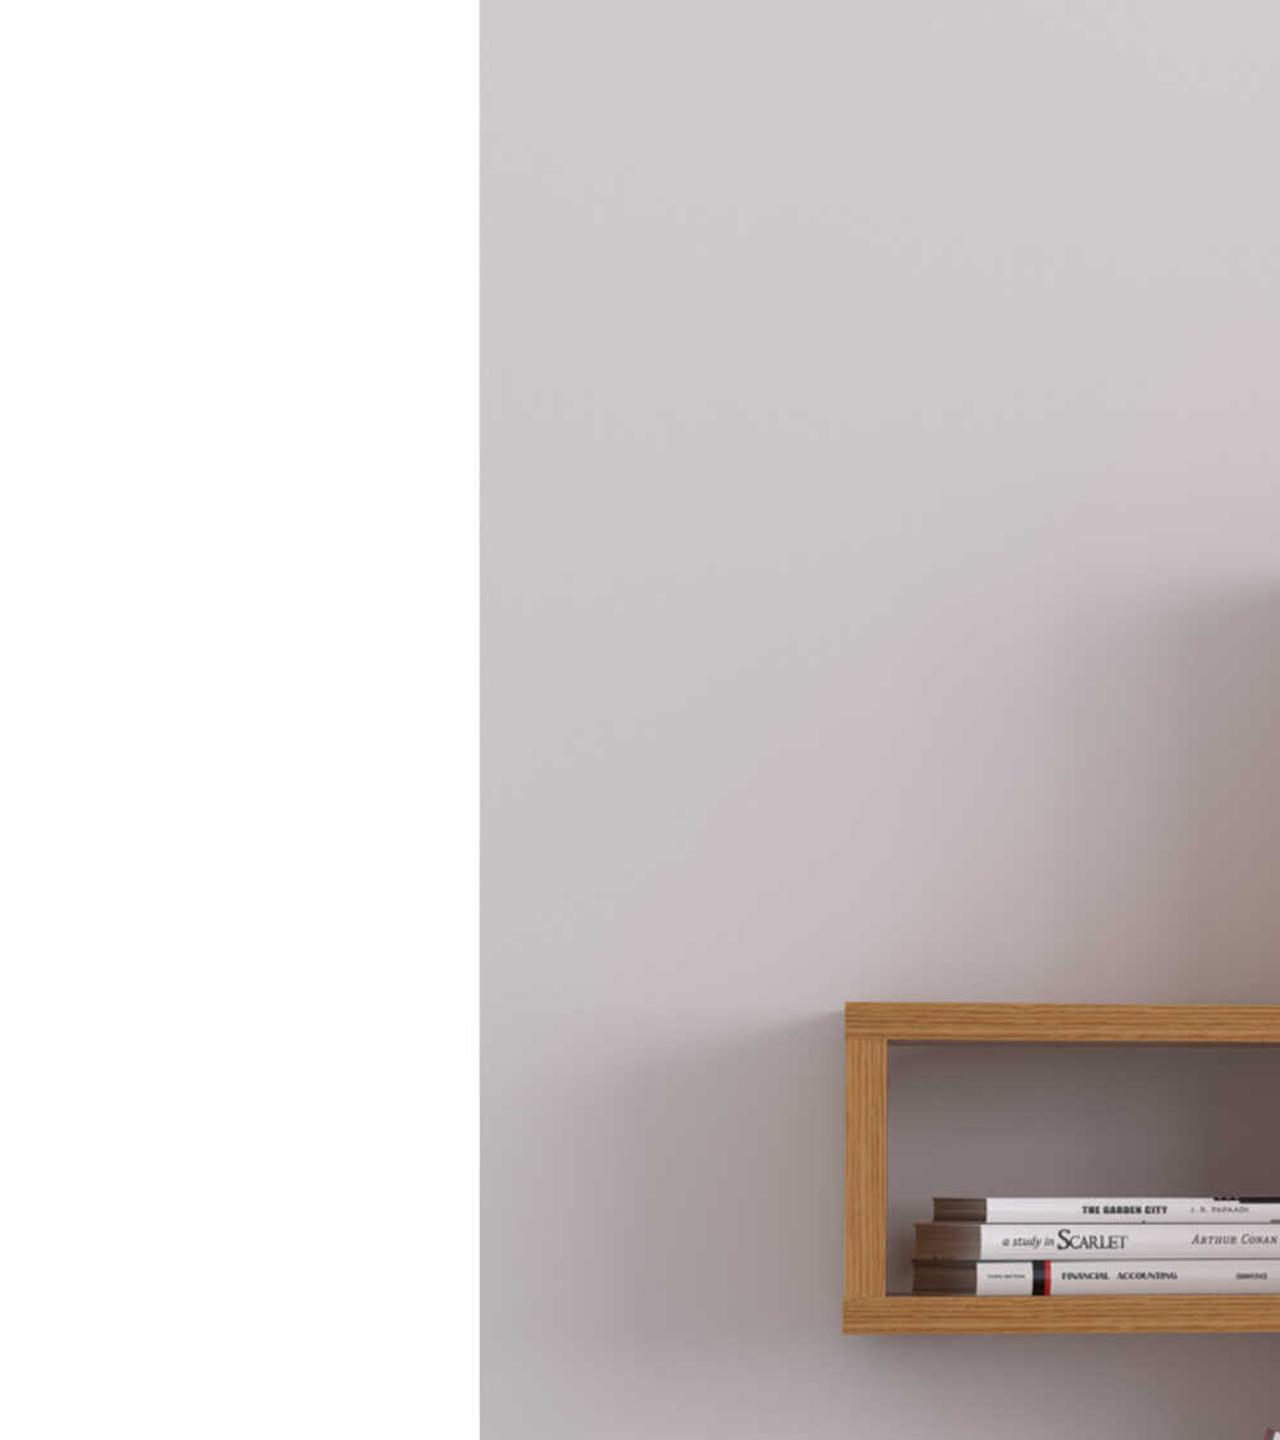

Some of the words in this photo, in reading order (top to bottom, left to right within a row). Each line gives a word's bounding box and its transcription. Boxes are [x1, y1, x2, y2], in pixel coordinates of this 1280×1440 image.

[1082, 1206, 1100, 1214] THE
[1103, 1206, 1141, 1214] GARDEN
[1144, 1206, 1167, 1214] CITY
[1002, 1238, 1010, 1247] a
[1012, 1235, 1041, 1248] study
[1044, 1236, 1054, 1246] in
[1061, 1272, 1109, 1280] FINANCIAL
[1116, 1272, 1177, 1280] ACCOUNTING
